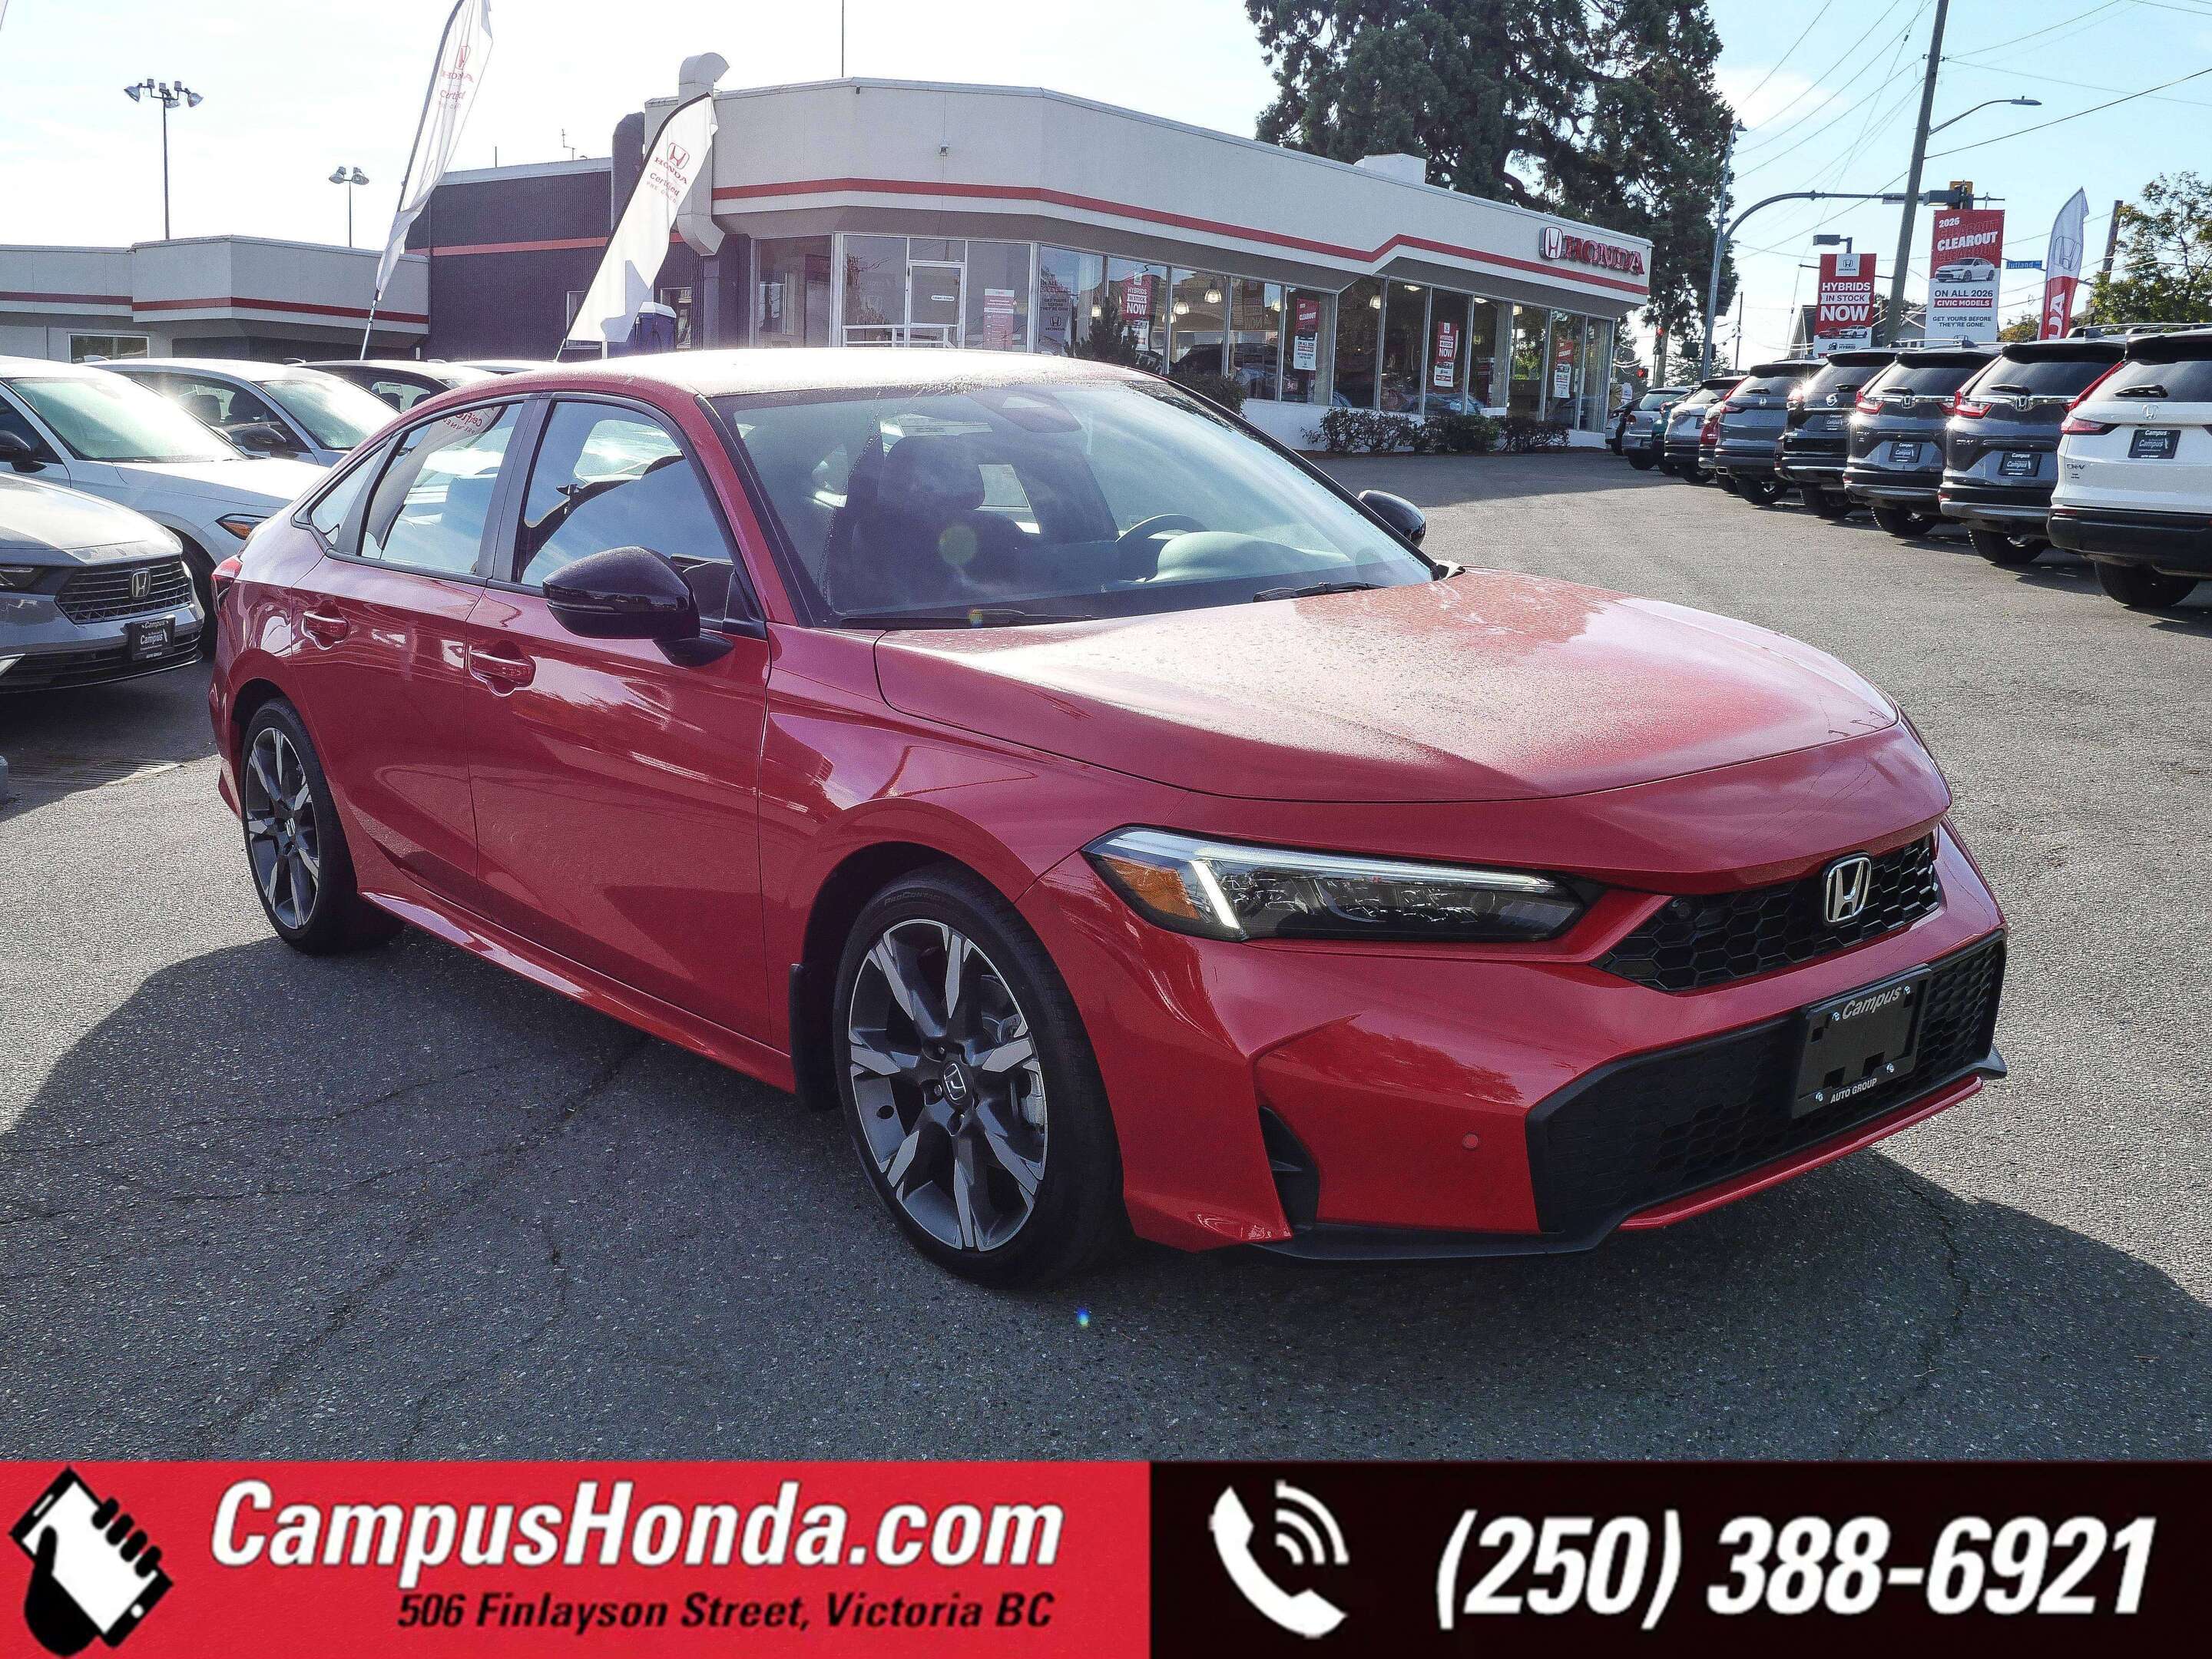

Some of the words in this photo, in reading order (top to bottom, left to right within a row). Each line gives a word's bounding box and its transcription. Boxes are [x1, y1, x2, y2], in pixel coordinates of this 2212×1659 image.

[1939, 217, 1960, 228] 2026
[1937, 231, 1998, 251] CLEAROUT
[1565, 235, 1644, 275] HONDA
[1822, 282, 1871, 291] HYBRIDS
[1127, 303, 1147, 315] NOW
[1820, 306, 1869, 321] NOW
[1439, 348, 1452, 358] NOW
[2139, 439, 2164, 448] Campus
[141, 634, 163, 644] Campus
[1842, 986, 1902, 1020] Campus
[1830, 1088, 1850, 1104] AUTO
[1852, 1078, 1877, 1094] GROUP
